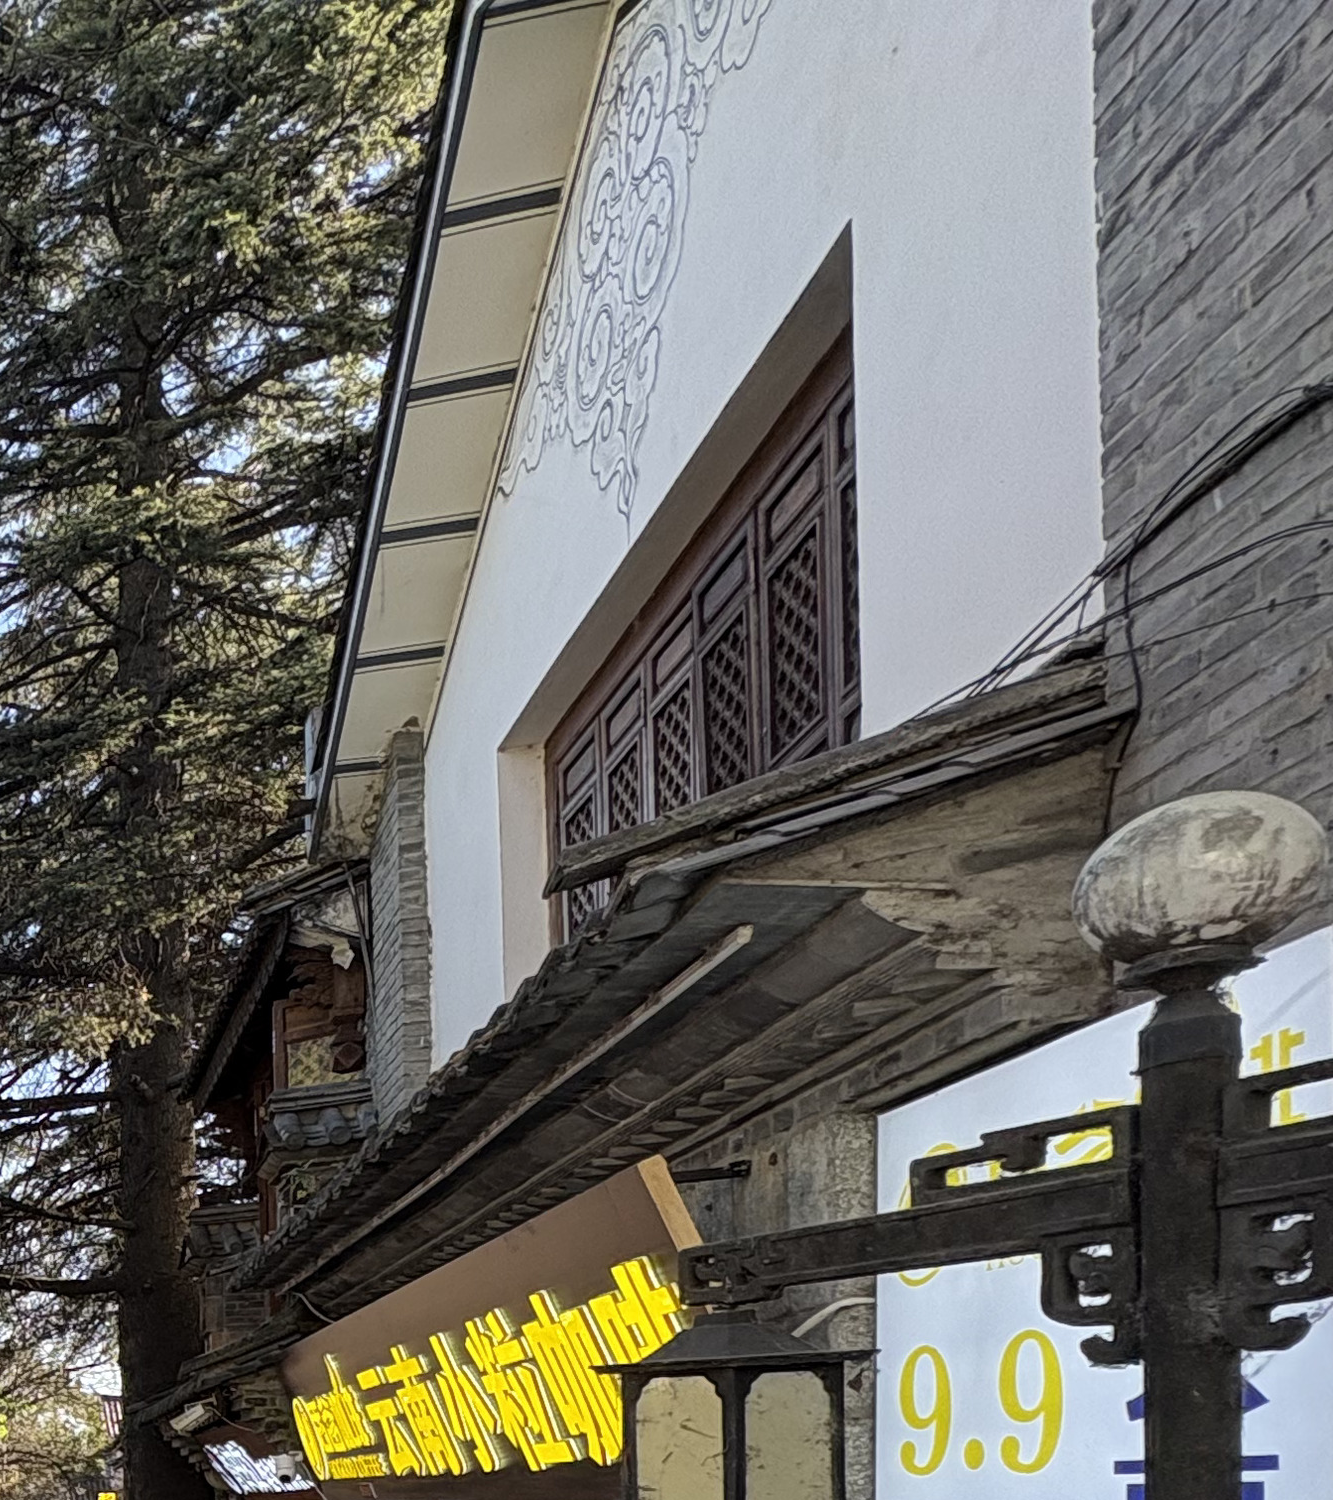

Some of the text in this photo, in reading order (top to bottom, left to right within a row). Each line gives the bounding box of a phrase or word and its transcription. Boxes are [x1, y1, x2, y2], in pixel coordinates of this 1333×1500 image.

[356, 1254, 686, 1477] 云南小粒咖啡
